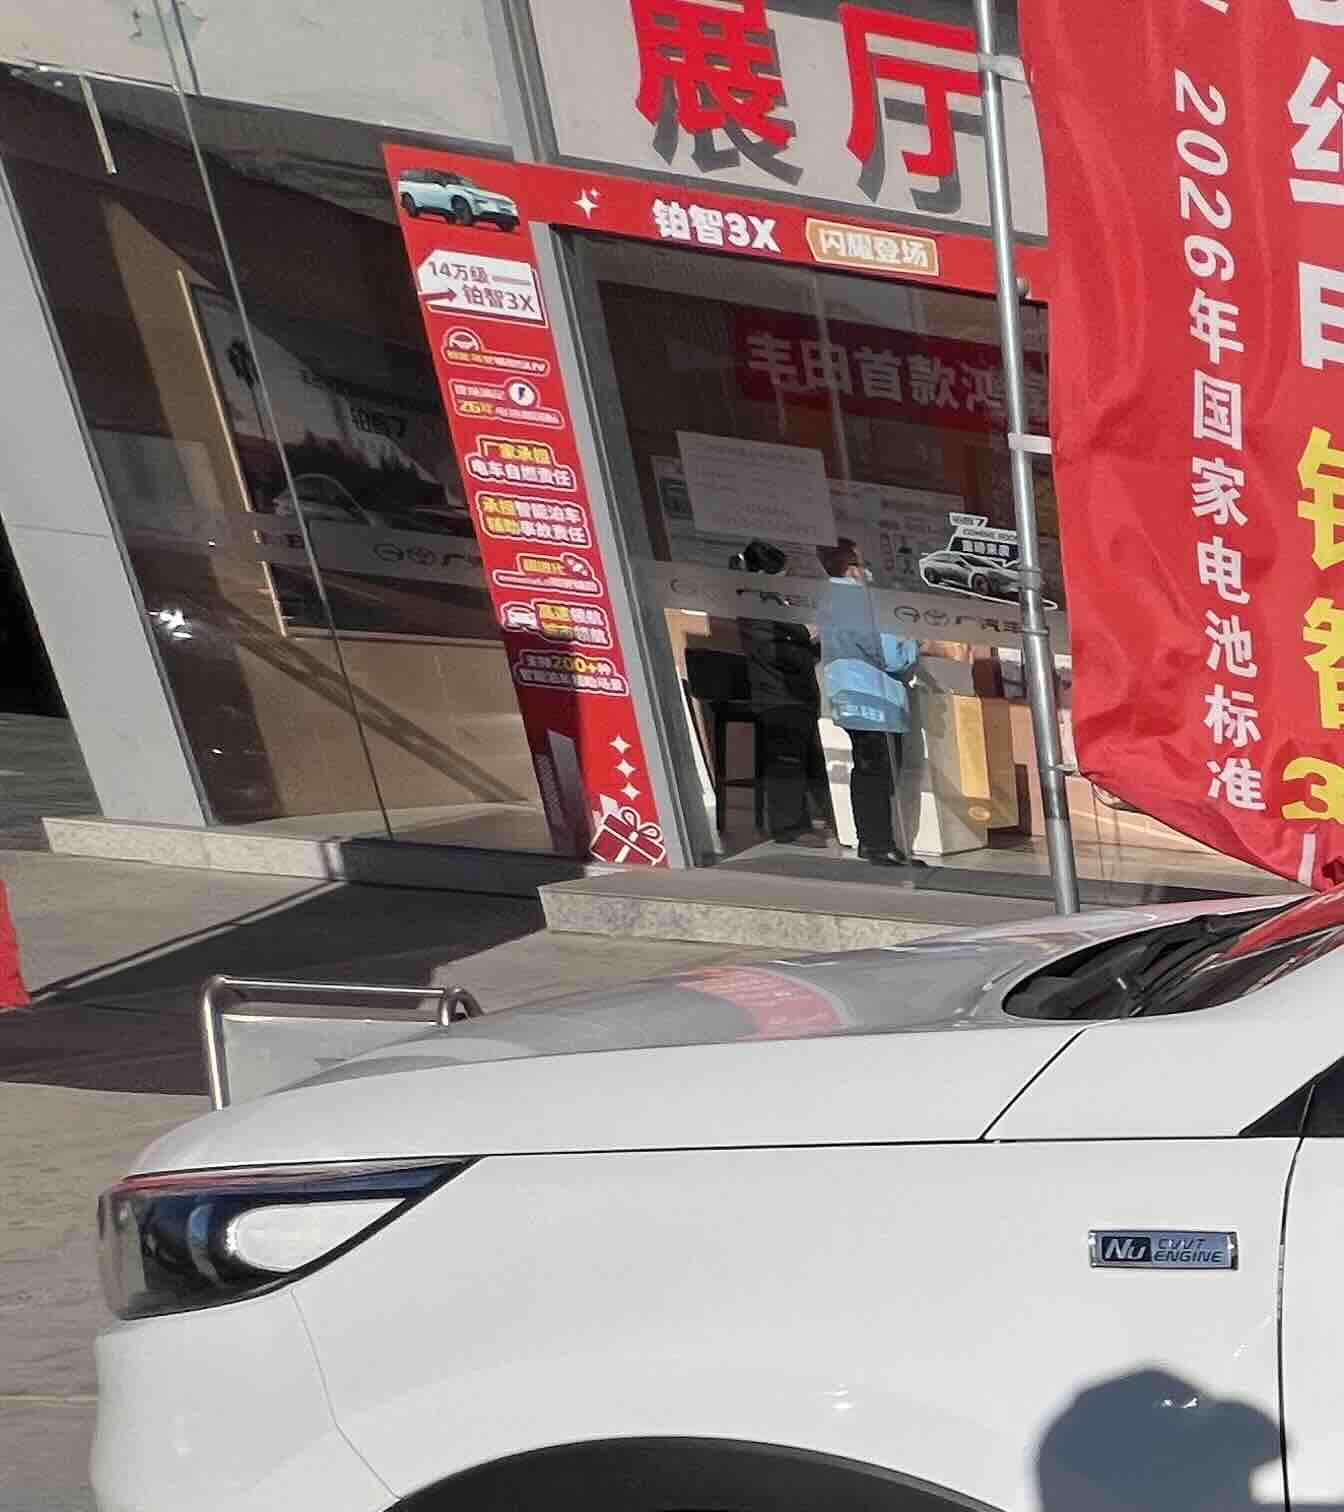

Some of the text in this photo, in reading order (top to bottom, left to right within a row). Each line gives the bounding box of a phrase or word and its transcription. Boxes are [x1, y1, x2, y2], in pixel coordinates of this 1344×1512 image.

[635, 0, 982, 178] 展厅
[651, 199, 930, 268] 铂智3X 闪耀登场
[428, 261, 490, 284] 14万级
[462, 284, 536, 314] 铂智3X
[1174, 68, 1267, 811] 2026年国家电池标准
[471, 458, 572, 487] 电车自燃责任
[1104, 1238, 1209, 1260] Nu CVVT
[1153, 1250, 1224, 1263] ENGINE
